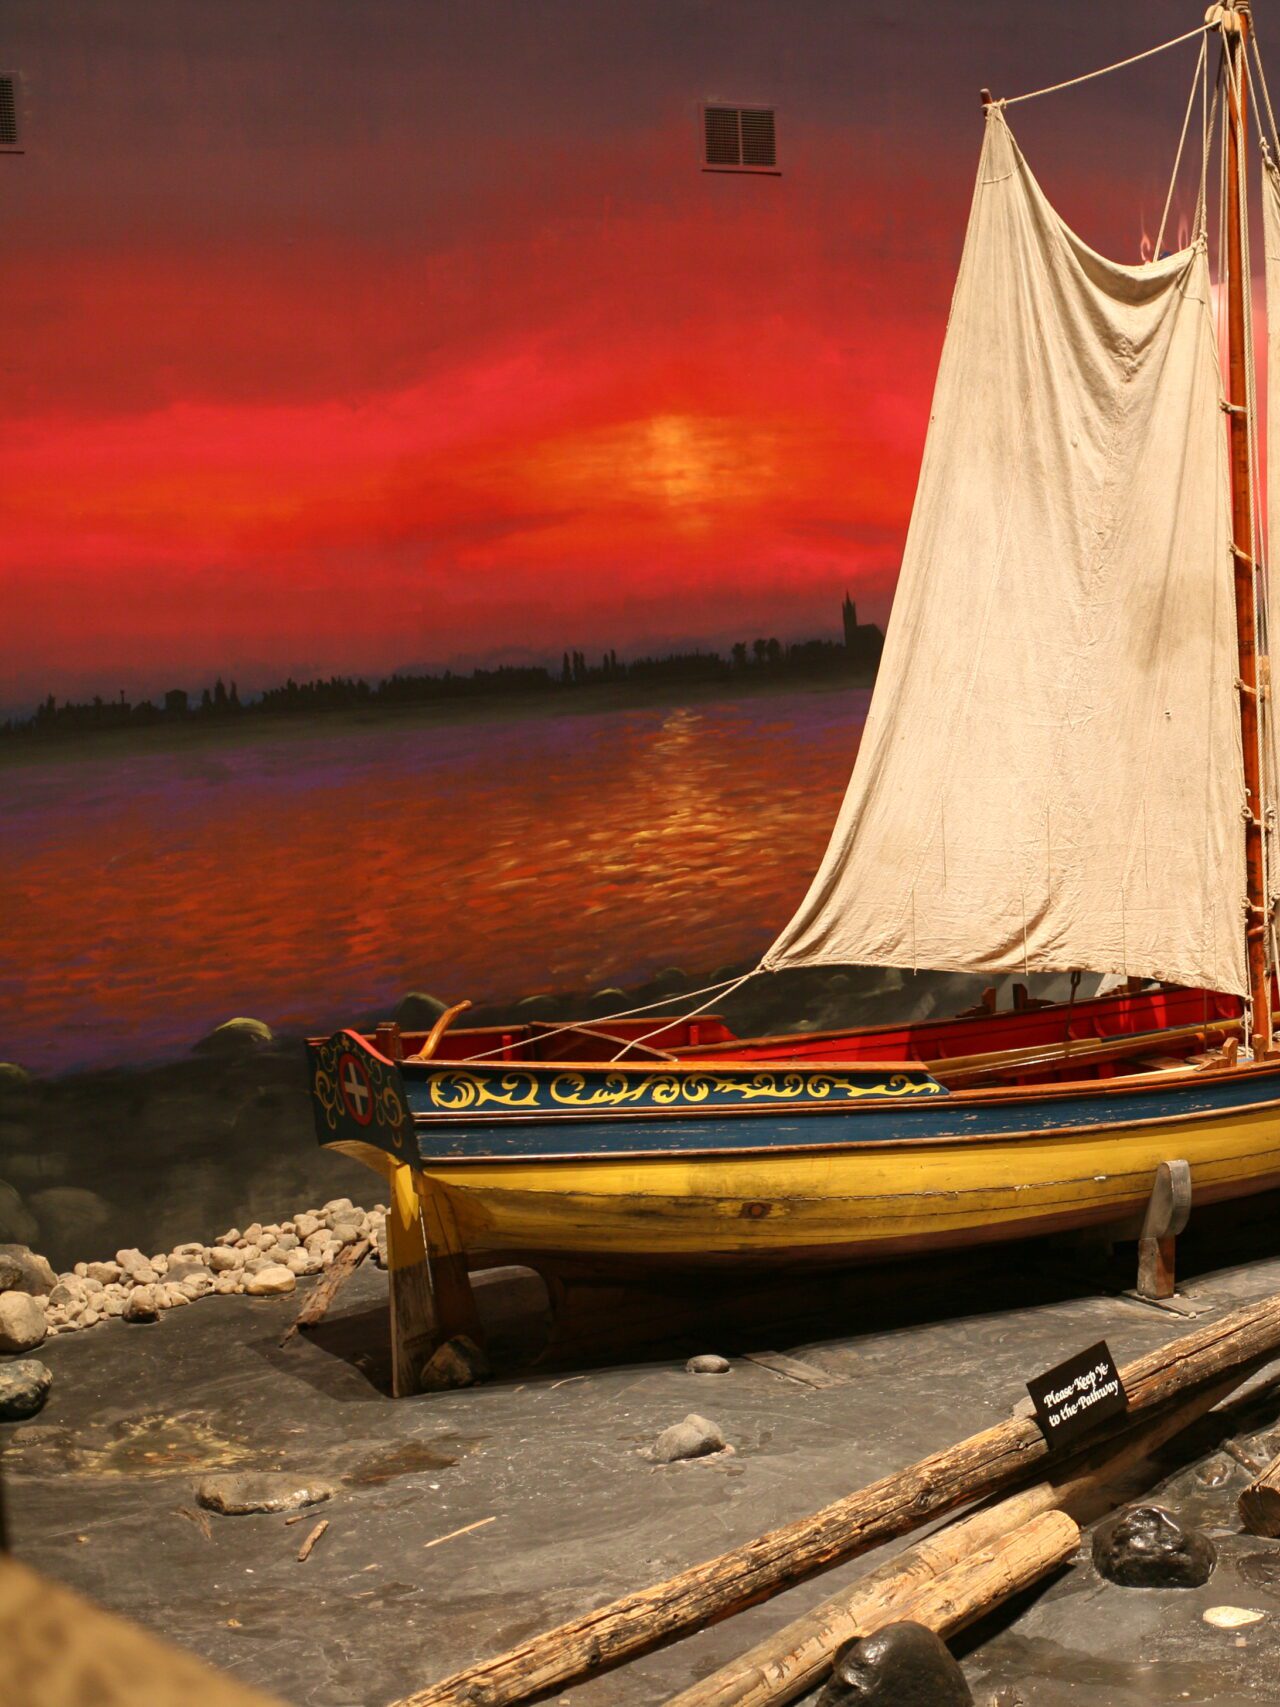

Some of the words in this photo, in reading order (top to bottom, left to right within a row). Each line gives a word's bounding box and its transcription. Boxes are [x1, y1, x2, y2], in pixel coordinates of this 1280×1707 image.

[1043, 1385, 1075, 1408] Please
[1074, 1371, 1097, 1391] Keep
[1095, 1362, 1109, 1381] Ye
[1049, 1414, 1061, 1427] to
[1060, 1403, 1078, 1421] the
[1077, 1379, 1119, 1410] Pathway
